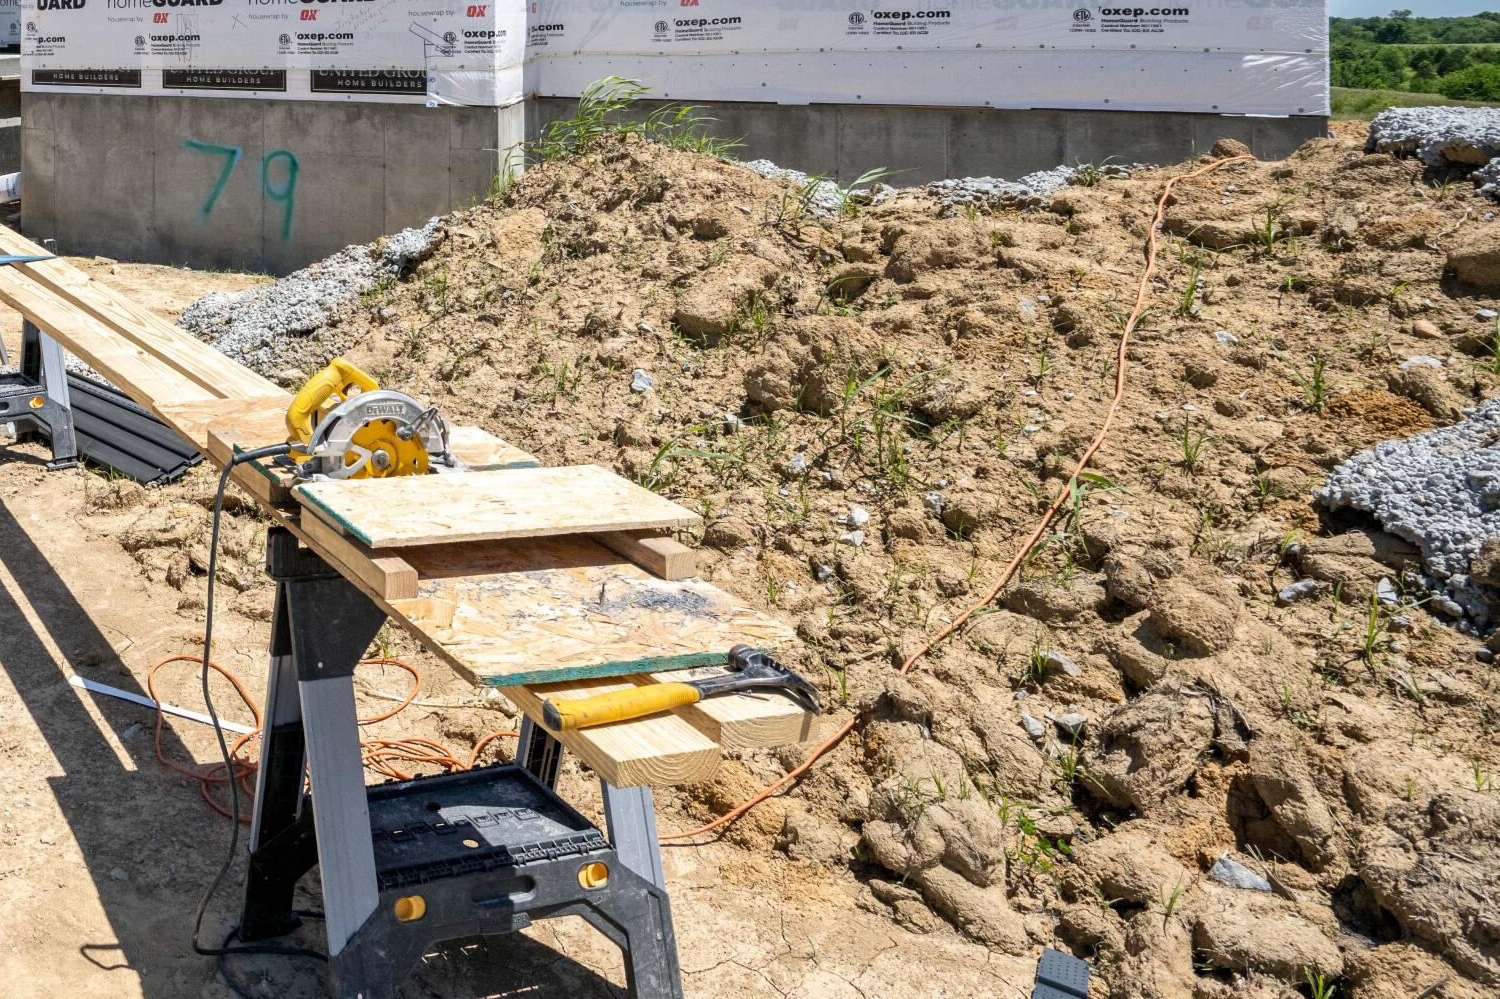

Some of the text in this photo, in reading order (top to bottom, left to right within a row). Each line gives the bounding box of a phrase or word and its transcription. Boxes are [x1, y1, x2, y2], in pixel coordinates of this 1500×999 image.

[300, 9, 318, 21] OX
[466, 4, 487, 18] OX
[873, 10, 951, 20] oxep.com
[1101, 7, 1189, 18] oxep.com
[152, 12, 170, 24] OX
[675, 16, 741, 28] oxep.com
[150, 32, 201, 43] oxep.com
[296, 32, 354, 42] oxep.com
[78, 73, 120, 81] BUILDERS
[186, 76, 262, 85] HOME BUILDERS
[337, 79, 423, 88] HOME BUILDERS
[181, 138, 299, 246] 79
